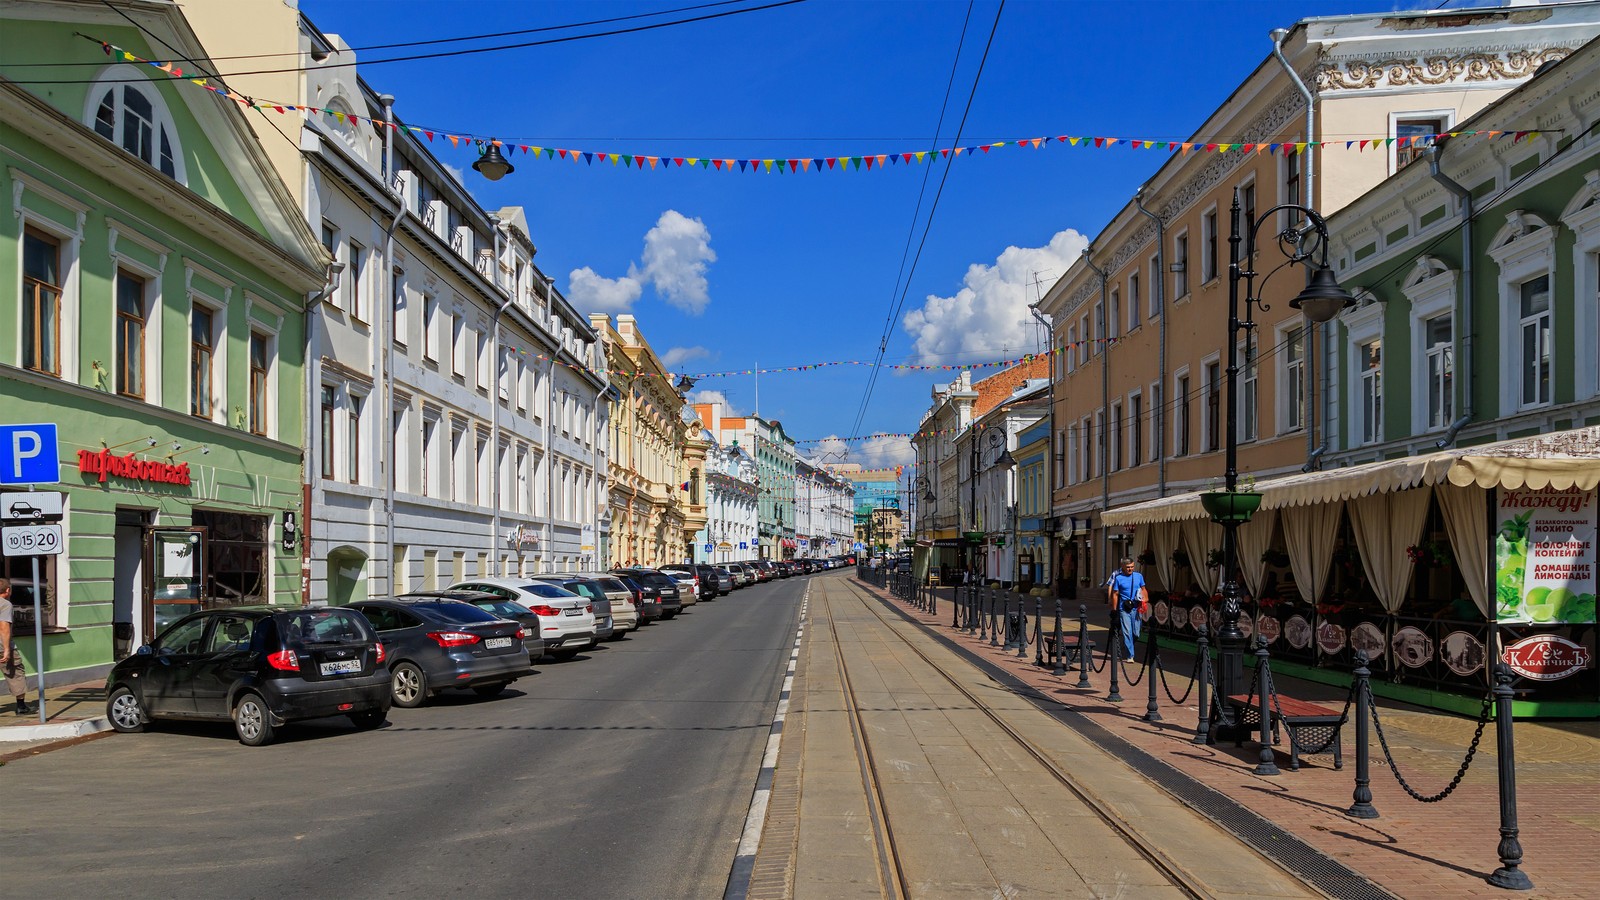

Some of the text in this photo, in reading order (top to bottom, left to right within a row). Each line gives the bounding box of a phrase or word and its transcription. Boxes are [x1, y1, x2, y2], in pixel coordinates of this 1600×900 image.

[12, 430, 42, 478] P
[1500, 491, 1592, 513] Жажду!
[1534, 525, 1574, 533] МОХИТО
[9, 533, 55, 546] 10 15 20
[1534, 541, 1591, 549] МОЛОЧНЫЕ
[1534, 548, 1585, 557] КОКТЕЙЛИ
[1534, 564, 1591, 572] ДОМАШНИЕ
[1534, 572, 1591, 580] ЛИМОНАДЫ
